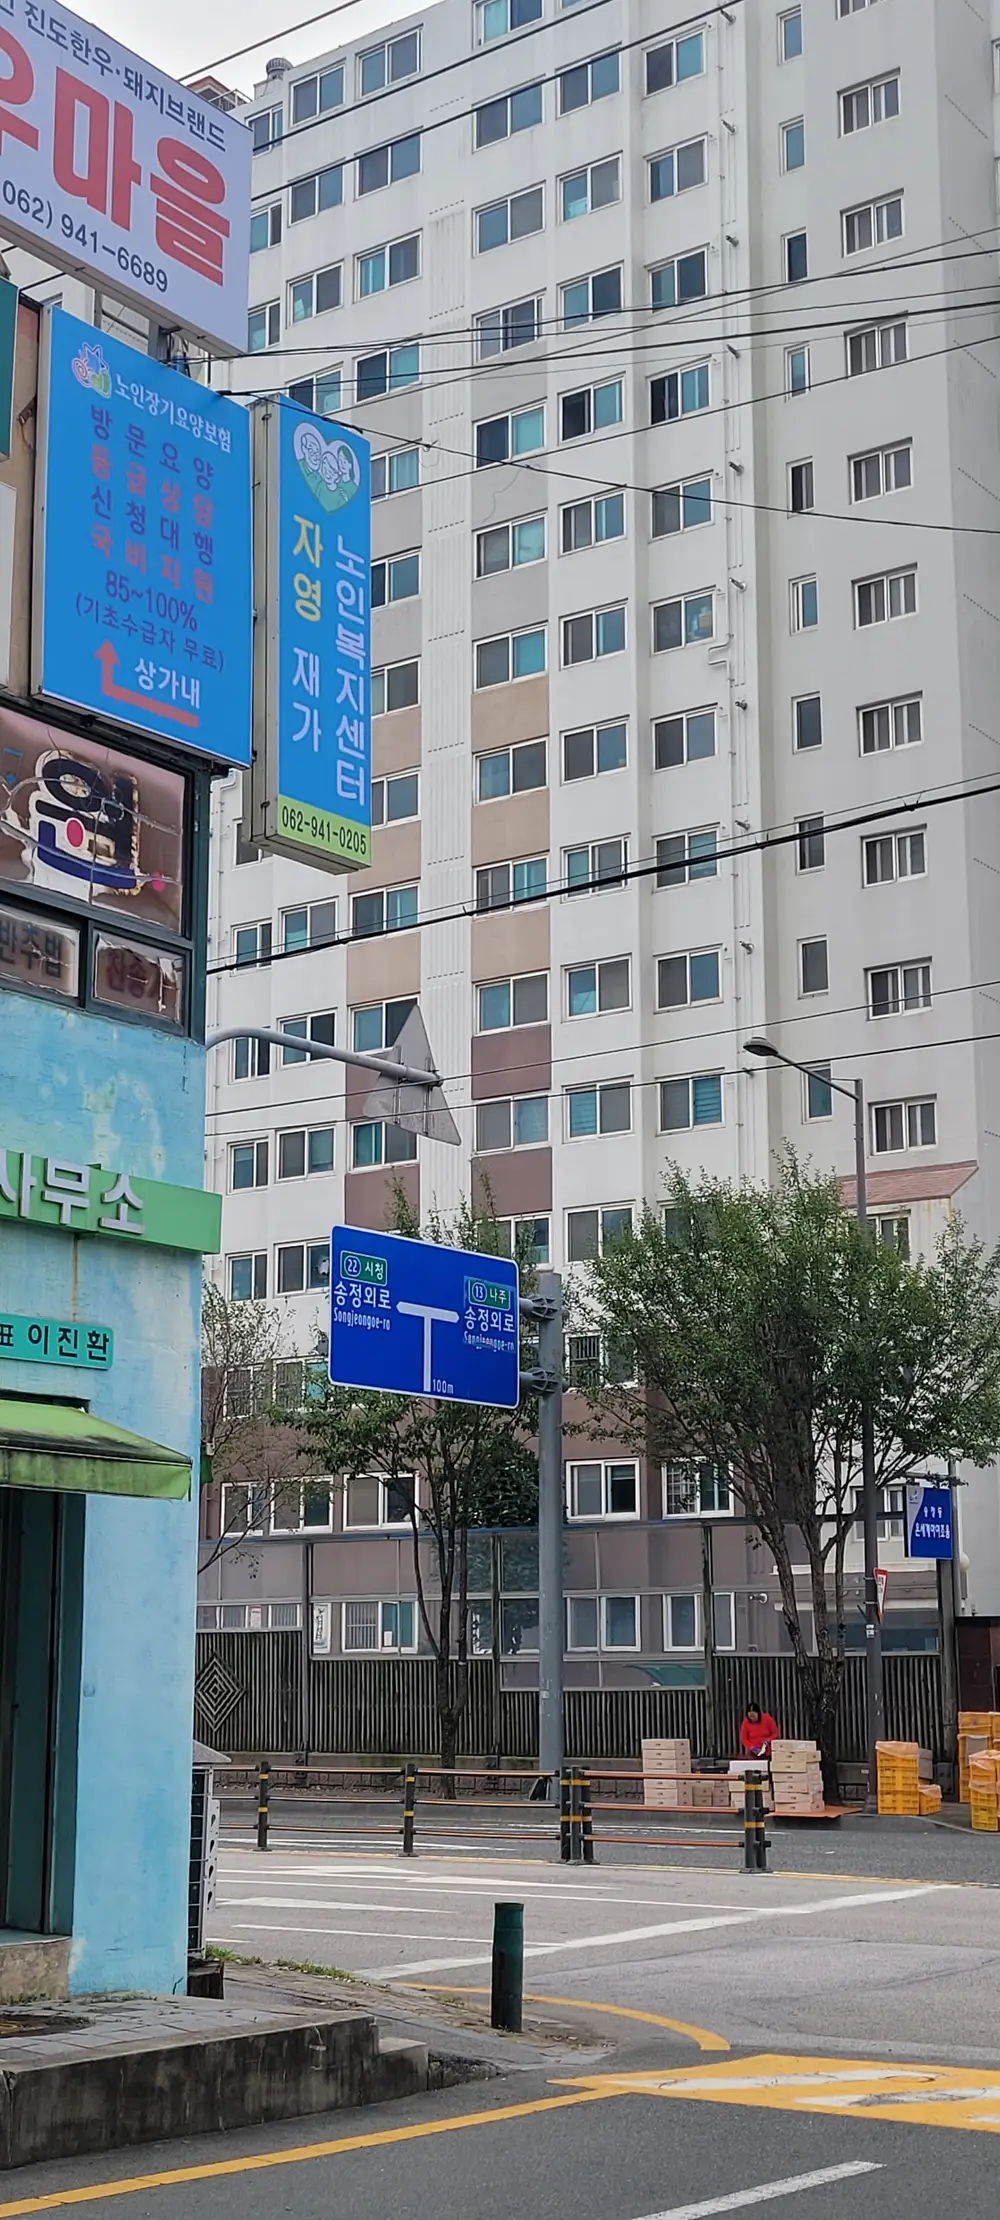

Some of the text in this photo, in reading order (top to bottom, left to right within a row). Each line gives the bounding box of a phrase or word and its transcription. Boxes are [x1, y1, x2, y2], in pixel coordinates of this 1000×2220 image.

[61, 213, 168, 292] 941-6689
[115, 374, 231, 453] 노인장기요양보험
[105, 570, 198, 632] 85~100%
[76, 593, 224, 673] (기초수급자 무료)
[292, 514, 323, 752] 자영 재가
[134, 657, 200, 709] 상가내
[335, 534, 367, 807] 노인복지센터
[282, 805, 367, 855] 062-941-0205
[345, 1259, 384, 1280] 22 시청
[333, 1280, 392, 1310] 송정외로
[333, 1306, 391, 1331] Songjeongoe-ro
[464, 1305, 515, 1333] 송정외로
[475, 1285, 507, 1305] 13 나주
[28, 1324, 110, 1361] 이진환
[432, 1379, 454, 1395] 100m
